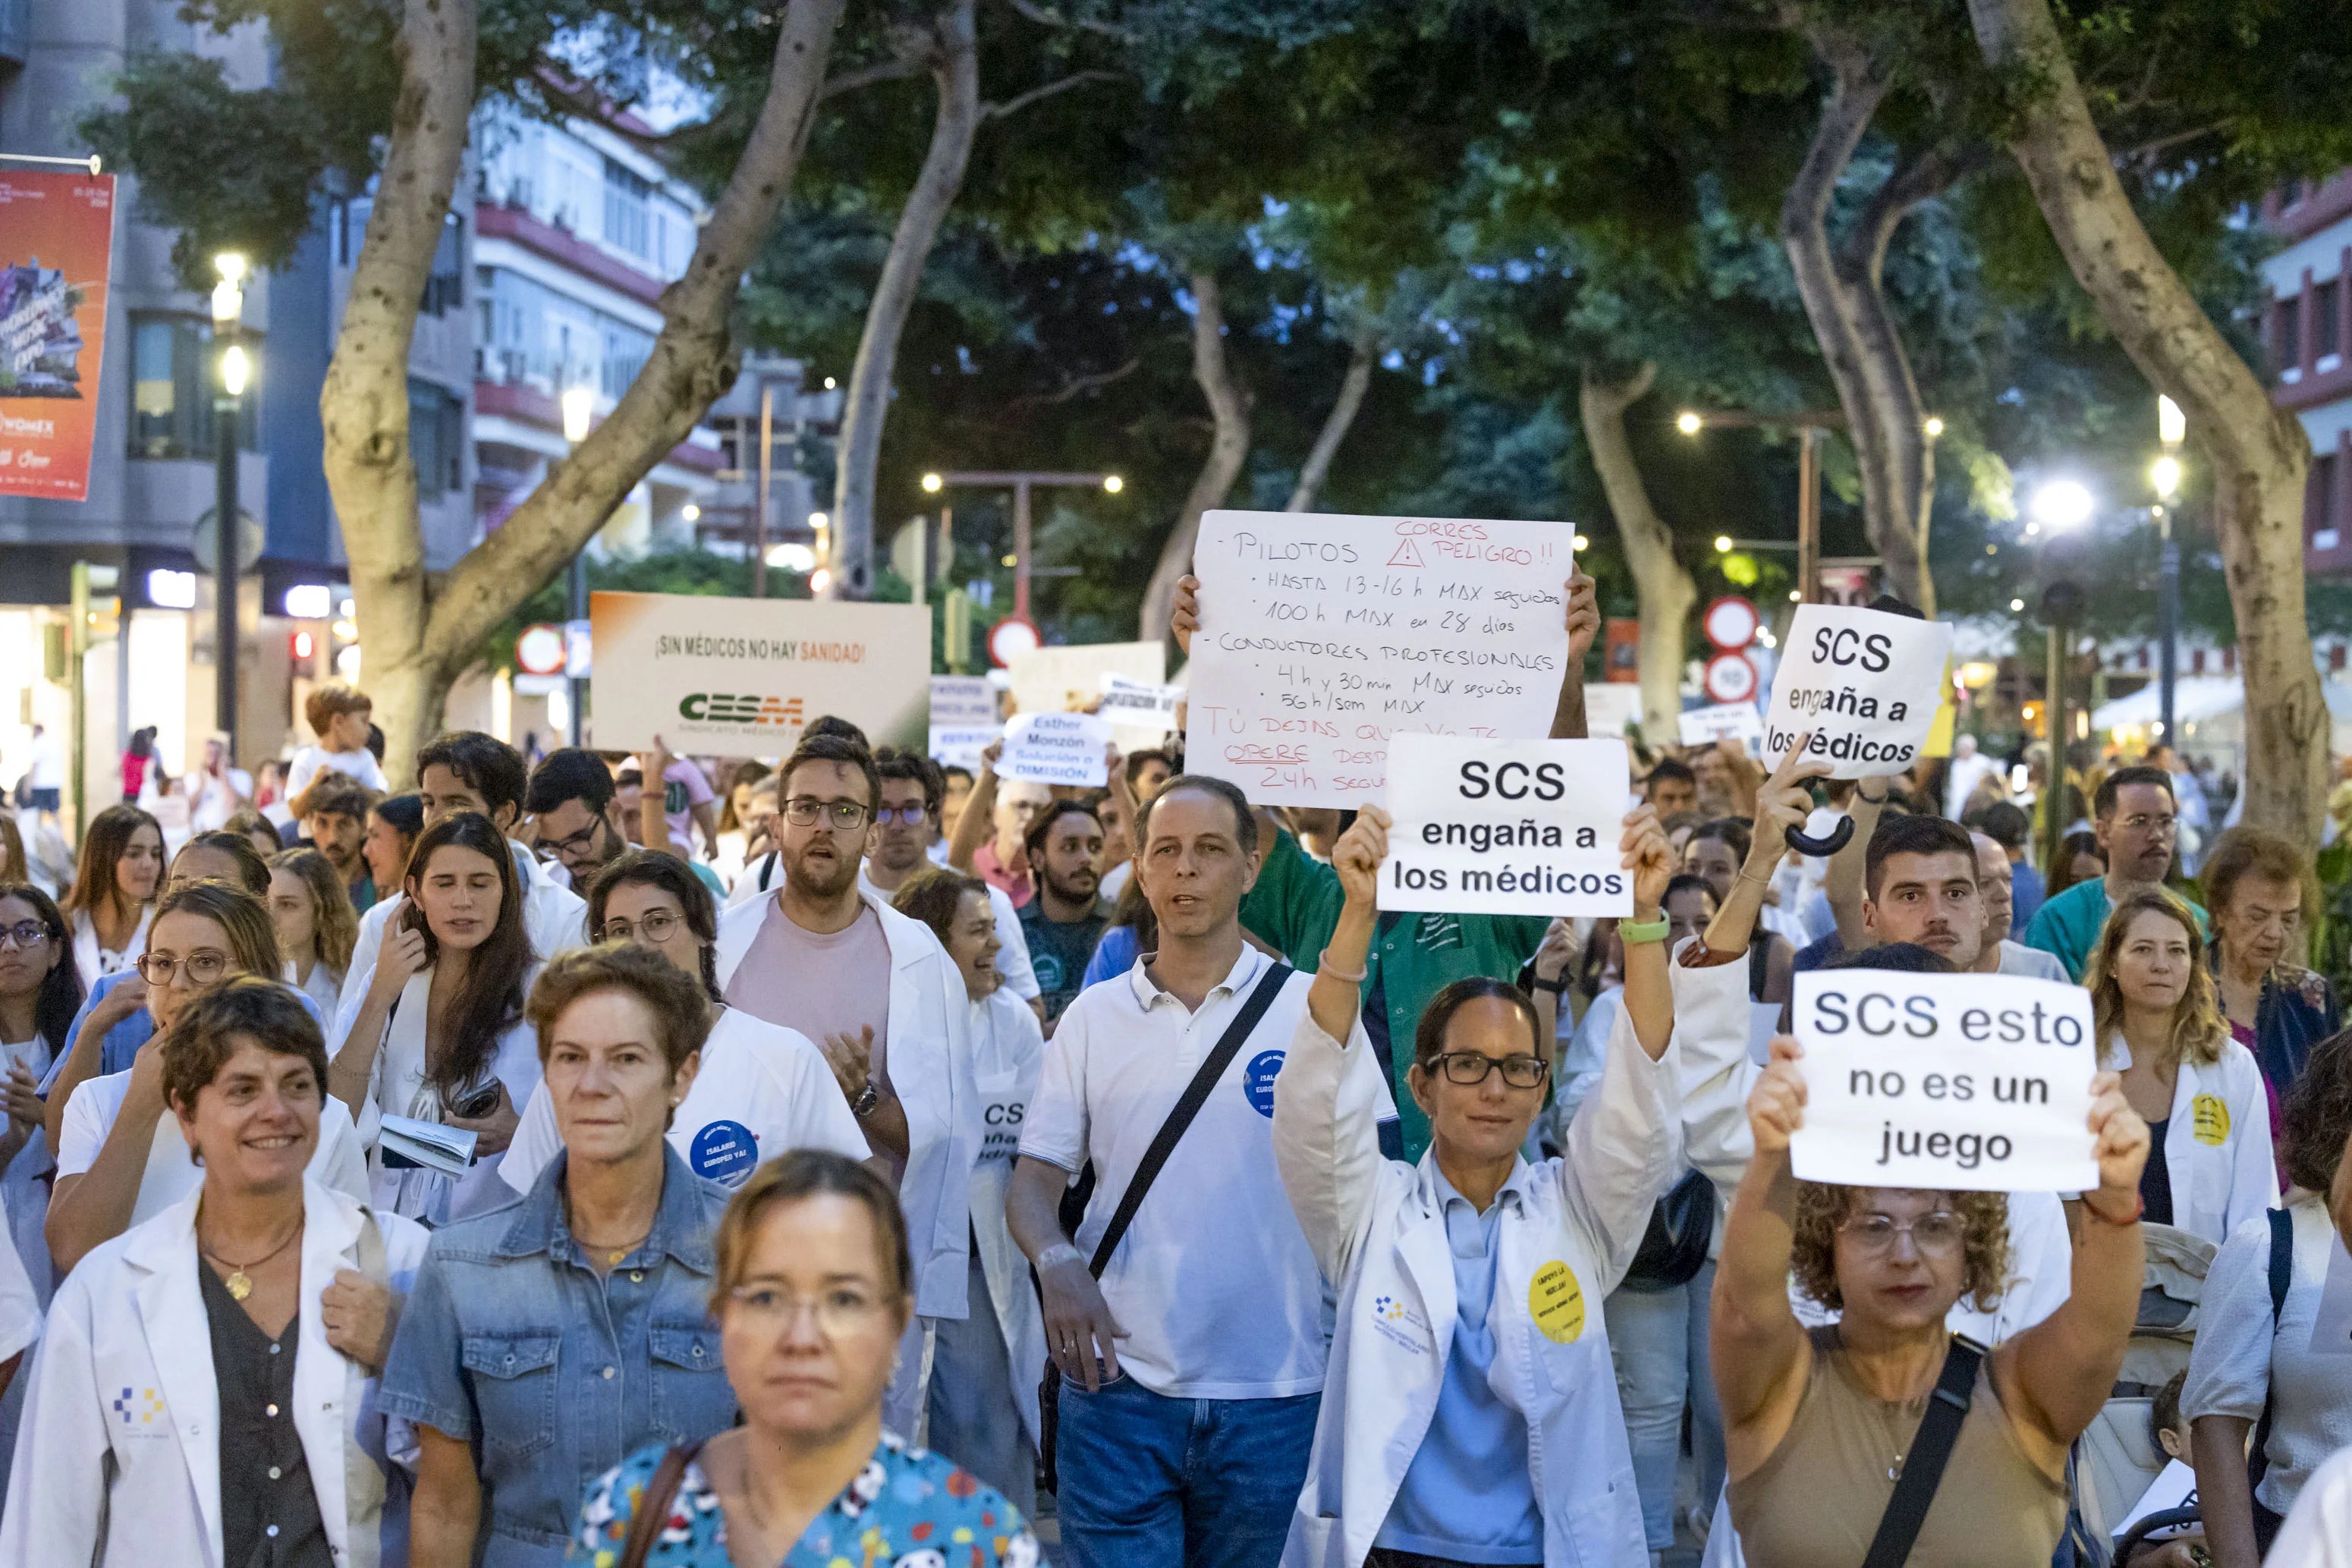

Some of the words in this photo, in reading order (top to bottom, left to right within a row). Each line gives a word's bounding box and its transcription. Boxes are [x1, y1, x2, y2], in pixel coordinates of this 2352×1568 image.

[1395, 521, 1488, 540] CORRES
[1234, 533, 1358, 563] PILOTOS
[1269, 573, 1326, 590] HASTA
[1439, 583, 1483, 602] MAX
[1346, 608, 1394, 627] MAX
[1441, 611, 1470, 633] 28
[684, 631, 746, 658] MÉDICOS
[748, 639, 768, 659] NO
[771, 640, 797, 660] HAY
[801, 642, 866, 664] SANIDAD!
[1219, 633, 1369, 660] CONDUCTORES
[1380, 646, 1555, 671] PROFESIONALES
[1813, 627, 1891, 672] SCS
[1413, 672, 1454, 694] MAX
[679, 693, 803, 725] CESM
[1384, 699, 1425, 714] MAX
[1789, 687, 1879, 719] engaña
[1888, 701, 1907, 721] a
[1259, 718, 1340, 737] DEJAS
[1224, 744, 1309, 762] OPERE
[1460, 761, 1565, 801] SCS
[1423, 819, 1561, 853] engaña
[1576, 826, 1596, 848] a
[1395, 860, 1448, 891] los
[1462, 864, 1623, 894] médicos
[1814, 991, 1939, 1038] SCS
[1961, 1001, 2083, 1047] esto
[1850, 1069, 1906, 1098] no
[1923, 1073, 1974, 1101] es
[1993, 1076, 2049, 1105] un
[1876, 1121, 2013, 1170] juego
